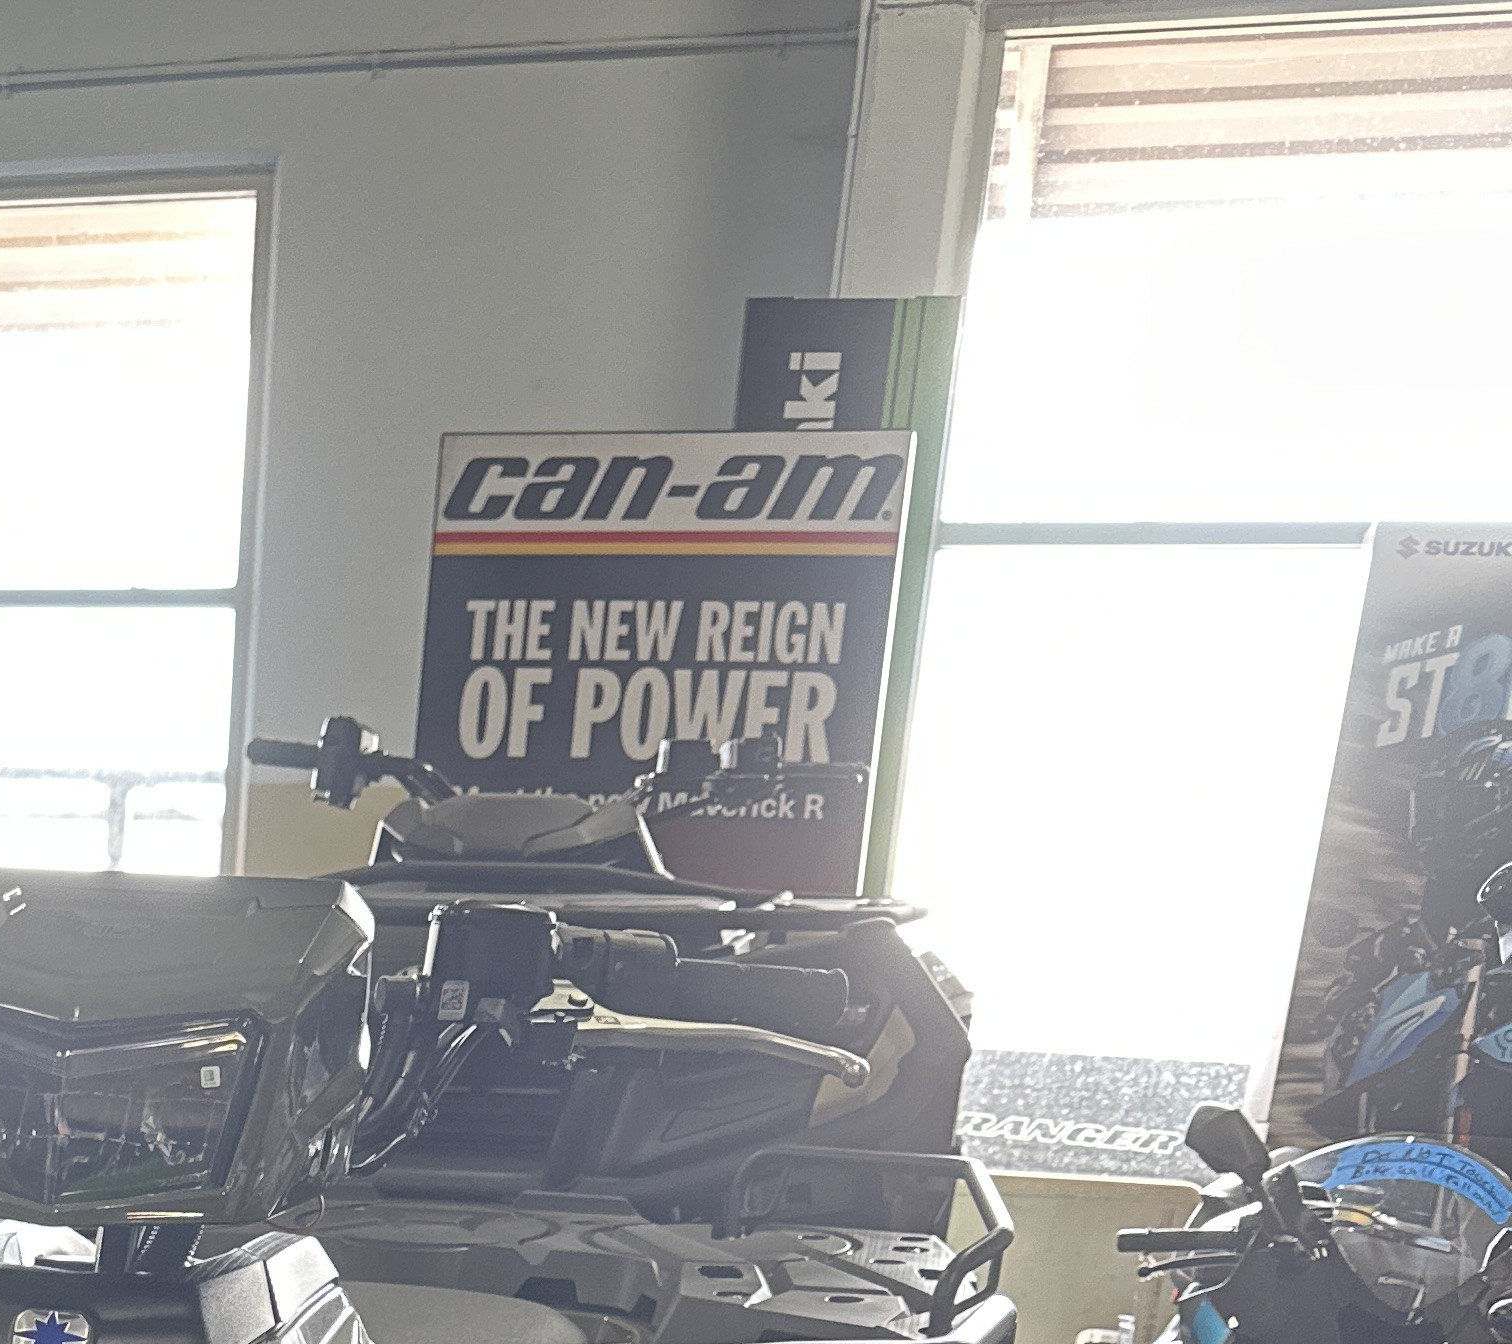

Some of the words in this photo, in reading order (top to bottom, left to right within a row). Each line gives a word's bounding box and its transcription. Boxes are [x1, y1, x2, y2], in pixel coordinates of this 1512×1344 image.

[783, 352, 842, 430] ki
[443, 453, 904, 522] can-am
[467, 600, 552, 662] THE
[568, 601, 684, 663] NEW
[695, 602, 847, 664] REIGN
[1383, 631, 1441, 664] MAKE
[1446, 625, 1464, 649] A
[458, 667, 552, 760] OF
[569, 668, 839, 763] POWER
[803, 793, 825, 820] R
[954, 1110, 1186, 1155] RANGER
